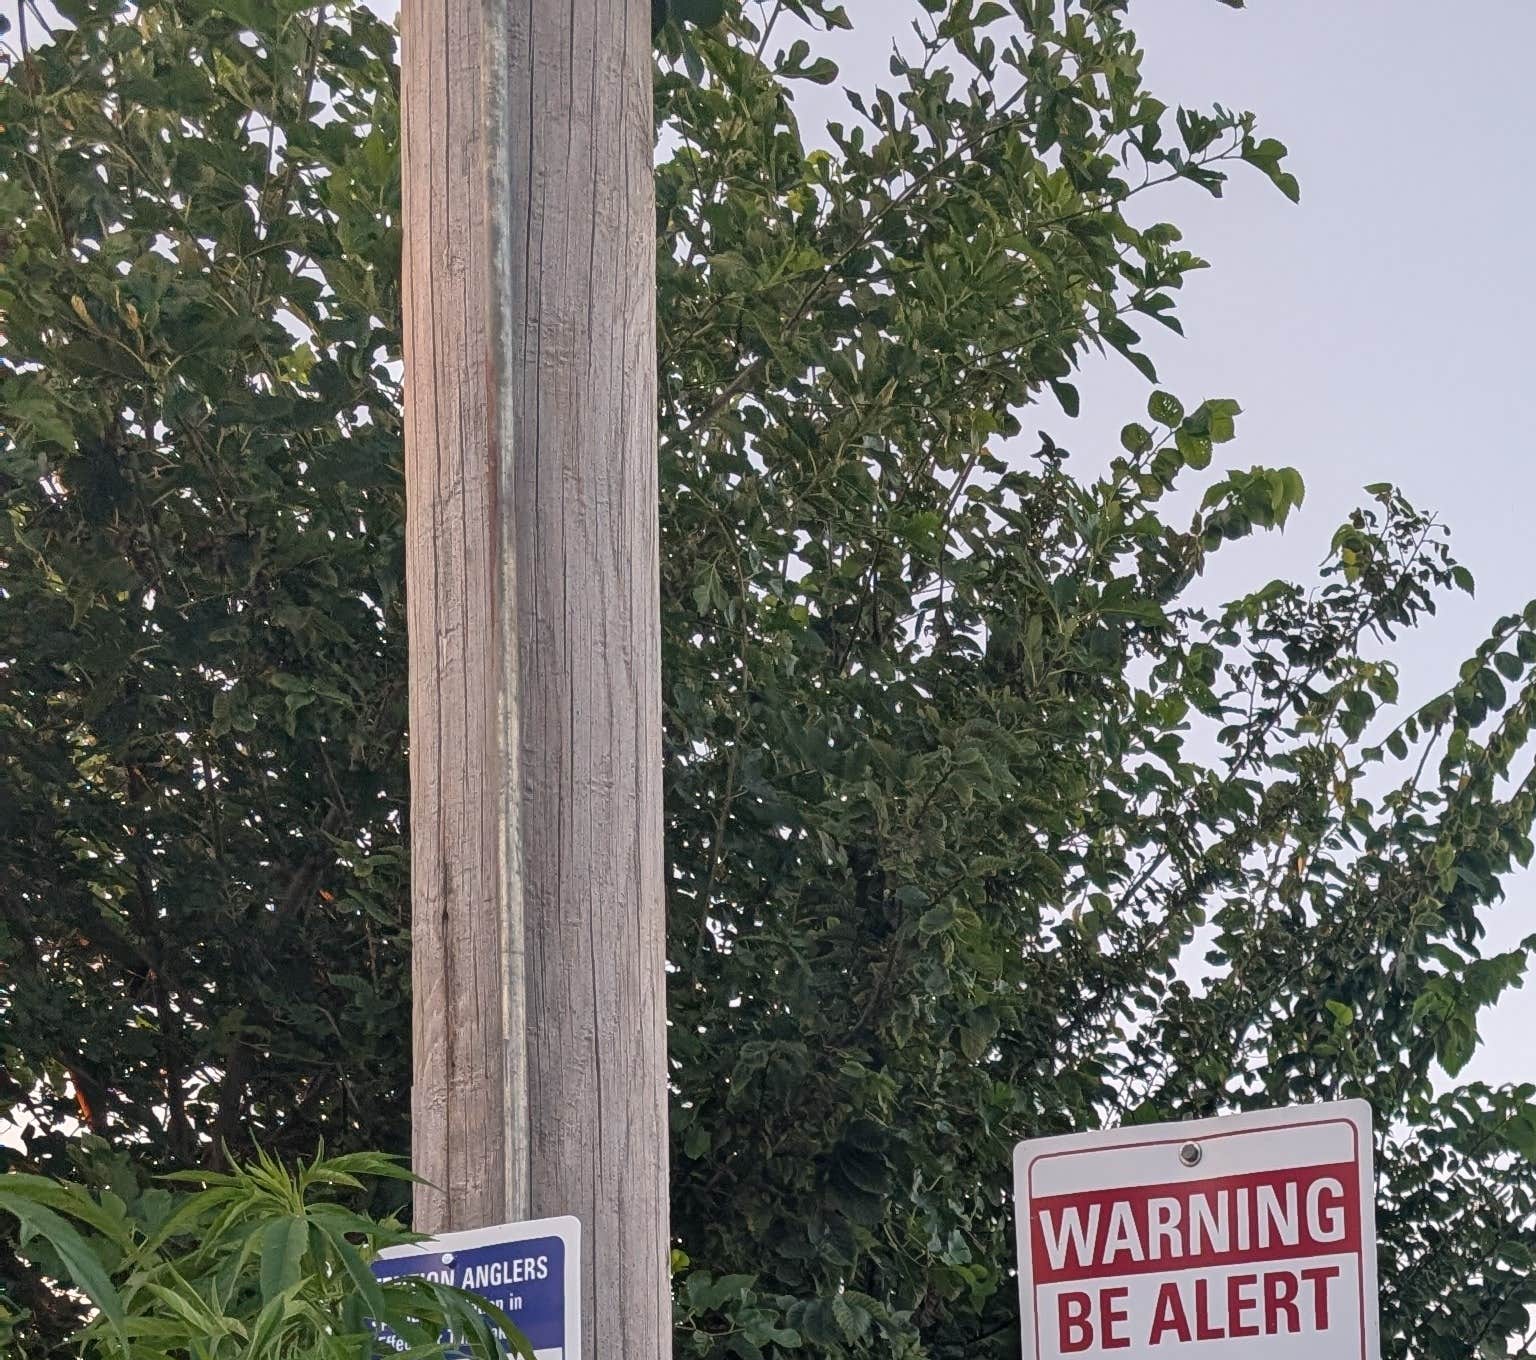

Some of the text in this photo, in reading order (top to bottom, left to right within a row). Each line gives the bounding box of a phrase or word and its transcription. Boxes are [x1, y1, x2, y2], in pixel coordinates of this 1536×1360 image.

[1038, 1177, 1346, 1271] WARNING
[461, 1255, 548, 1290] ANGLERS
[1057, 1265, 1340, 1354] BE ALERT
